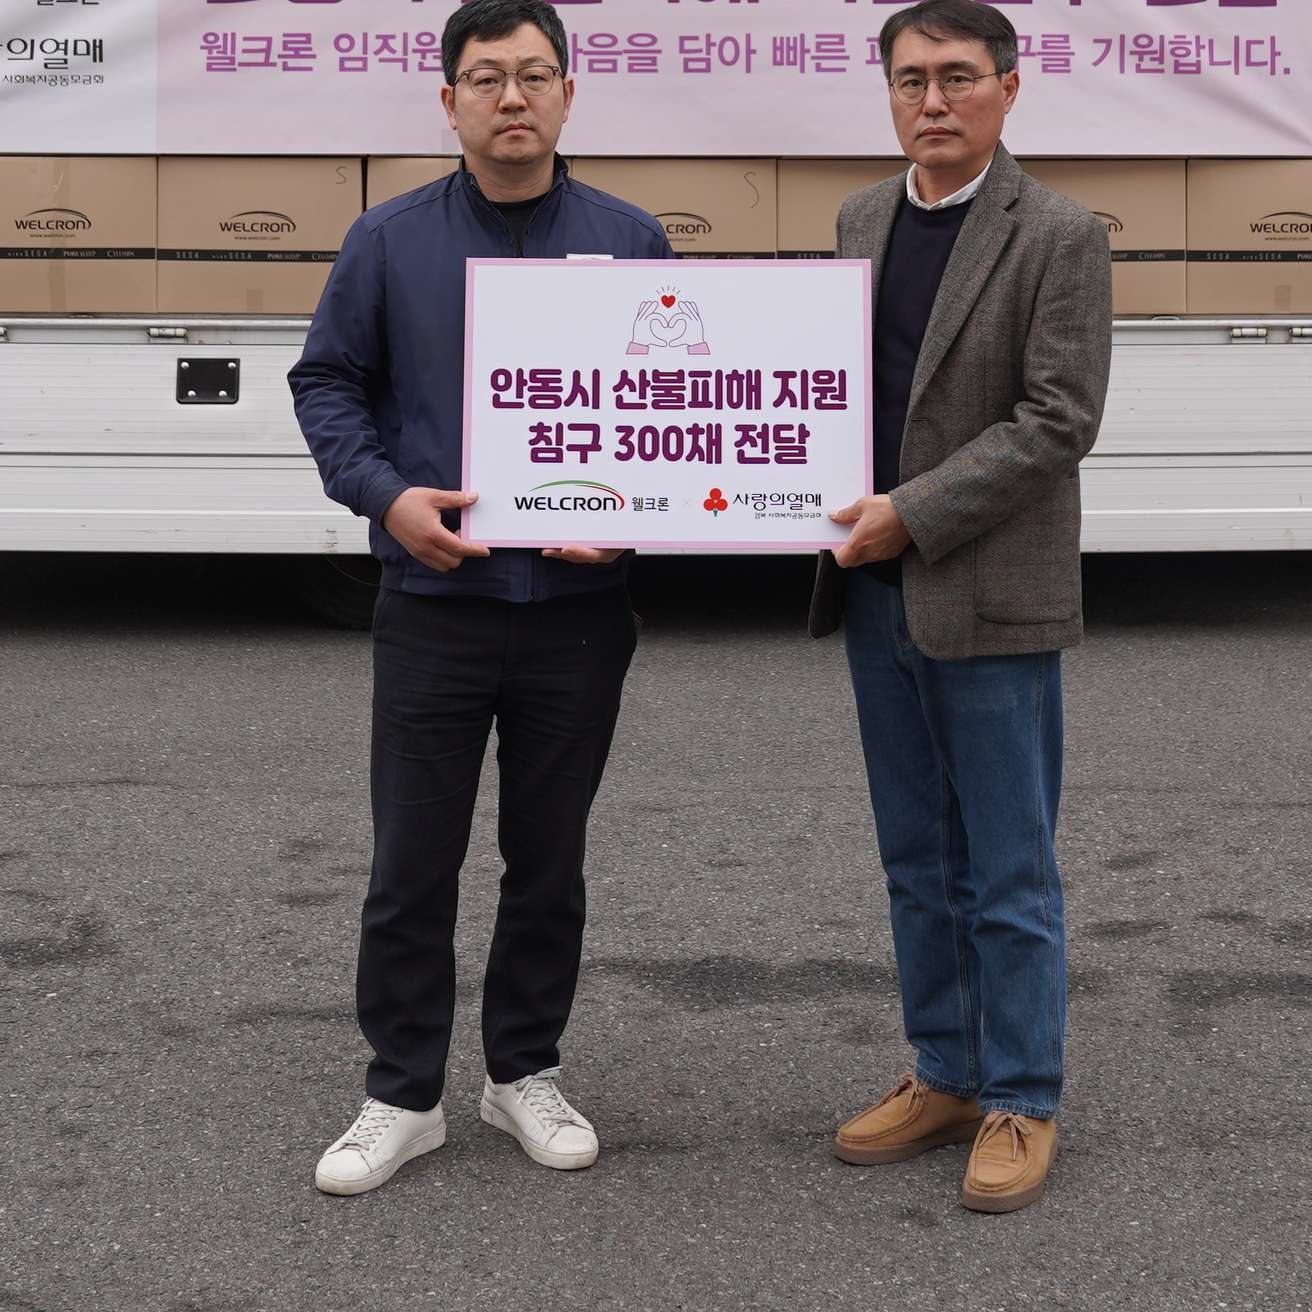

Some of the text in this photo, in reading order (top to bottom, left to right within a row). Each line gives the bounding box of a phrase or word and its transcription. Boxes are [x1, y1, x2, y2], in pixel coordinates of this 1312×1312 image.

[199, 31, 317, 73] 웰크론
[678, 32, 757, 74] 담아
[772, 32, 850, 74] 빠른
[1091, 33, 1291, 76] 기원합니다.
[2, 74, 104, 87] 사회복지공동모금회
[14, 220, 86, 230] WELCRON
[219, 222, 291, 233] WELCRON
[665, 224, 707, 234] CRON
[489, 368, 848, 410] 안동시 산불피해 지원
[528, 421, 810, 465] 침구 300채 전달
[513, 495, 670, 512] WELCRON 웰크론
[732, 492, 822, 512] 사랑의열매
